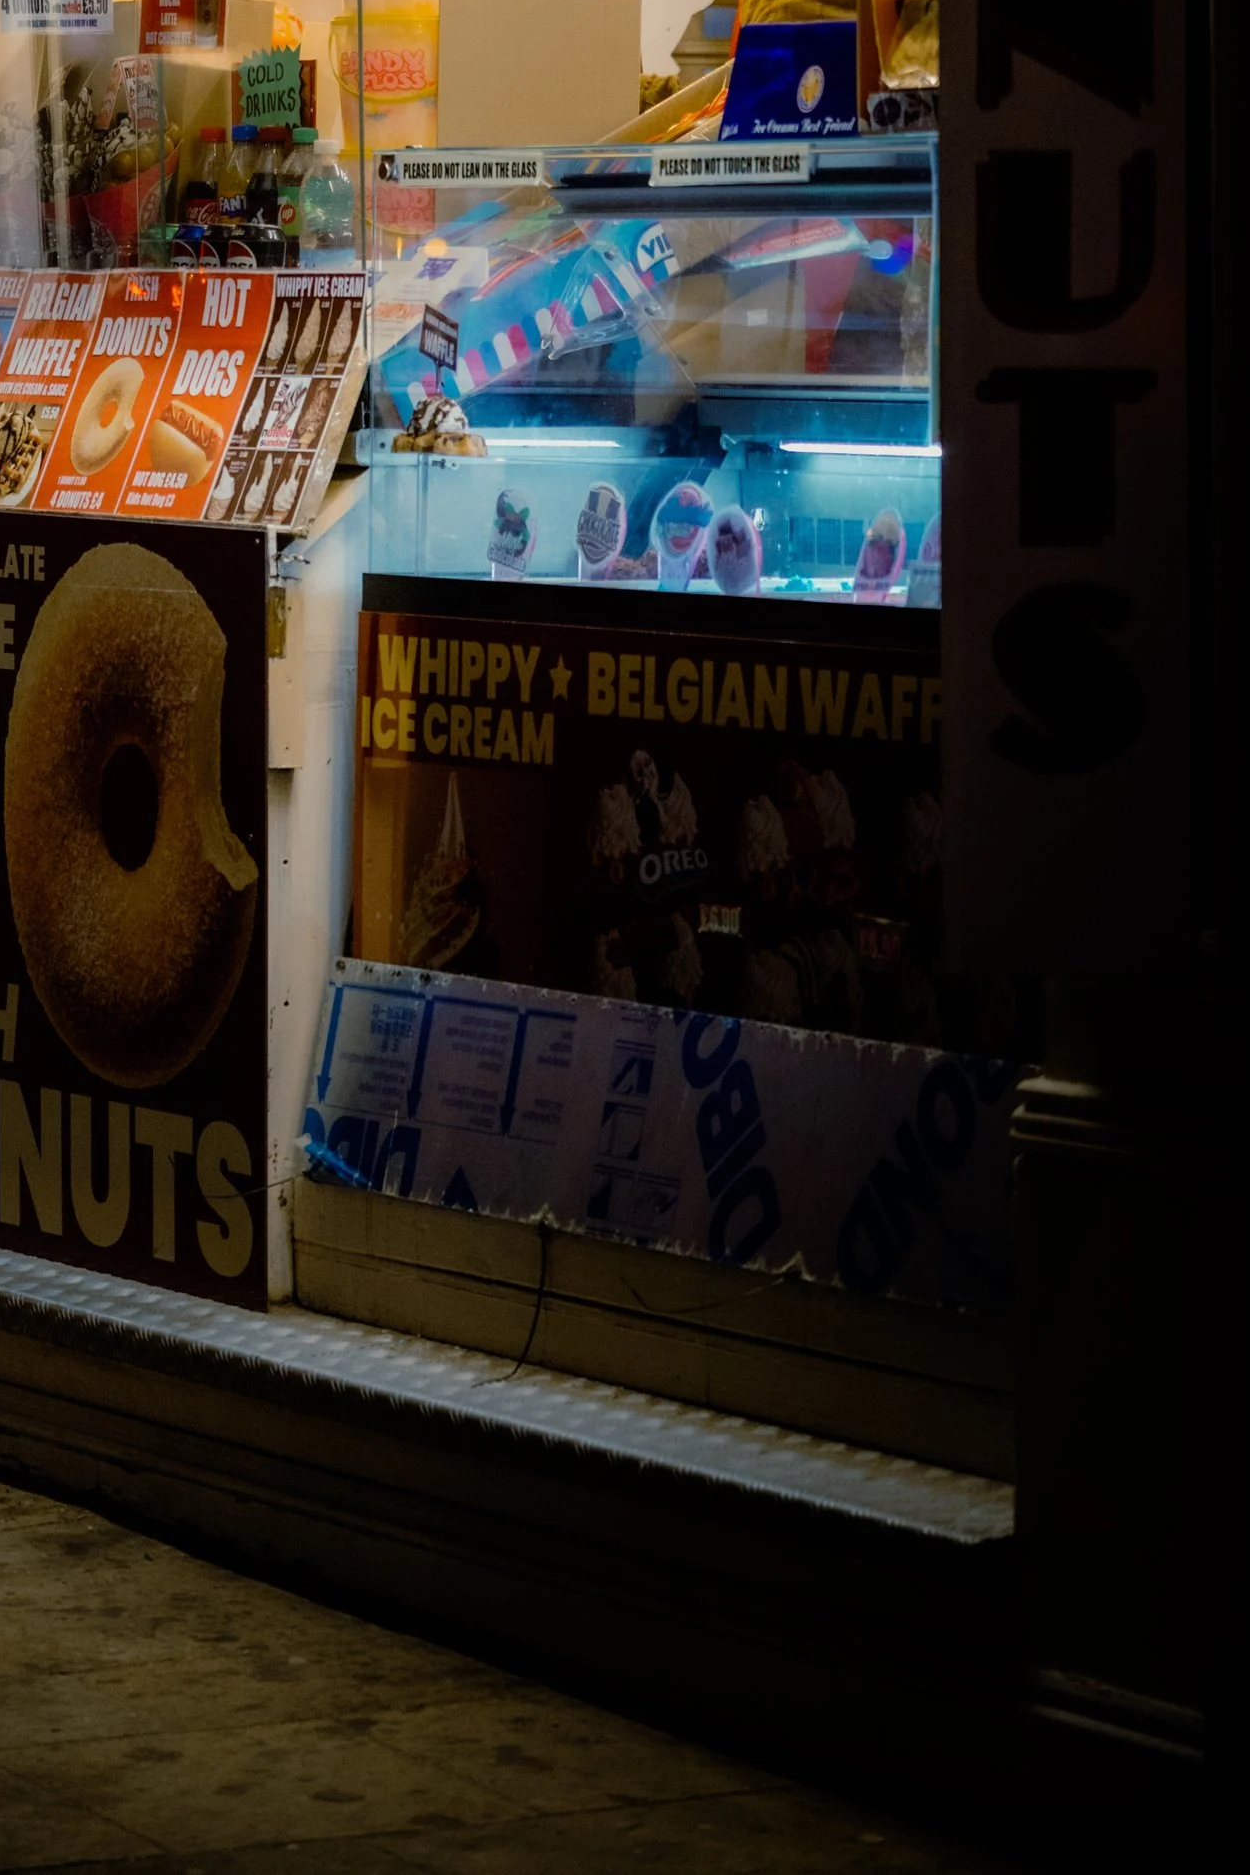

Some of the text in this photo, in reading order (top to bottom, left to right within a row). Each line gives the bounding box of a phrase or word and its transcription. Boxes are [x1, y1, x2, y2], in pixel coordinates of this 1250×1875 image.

[160, 12, 178, 25] LATTE
[247, 62, 284, 86] COLD
[245, 90, 296, 119] DRINKS
[403, 161, 537, 179] PLEASE DO NOT LEAN ON THE GLASS
[659, 155, 800, 176] PLEASE DO NOT TOUCH THE GLASS
[22, 281, 101, 322] BELGIAN
[124, 275, 160, 301] FRESH
[201, 277, 252, 328] HOT
[275, 276, 365, 298] WHIPPY ICE CREAM
[92, 316, 172, 358] DONUTS
[424, 328, 456, 367] WAFFLE
[7, 337, 83, 377] WAFFLE
[171, 349, 245, 397] DOGS
[132, 470, 188, 489] HOT DOG £4.50
[50, 490, 105, 510] 4 DONUTS £4
[377, 632, 545, 702] WHIPPY
[586, 650, 790, 733] BELGIAN
[359, 694, 556, 766] ICE CREAM
[638, 847, 709, 887] OREO
